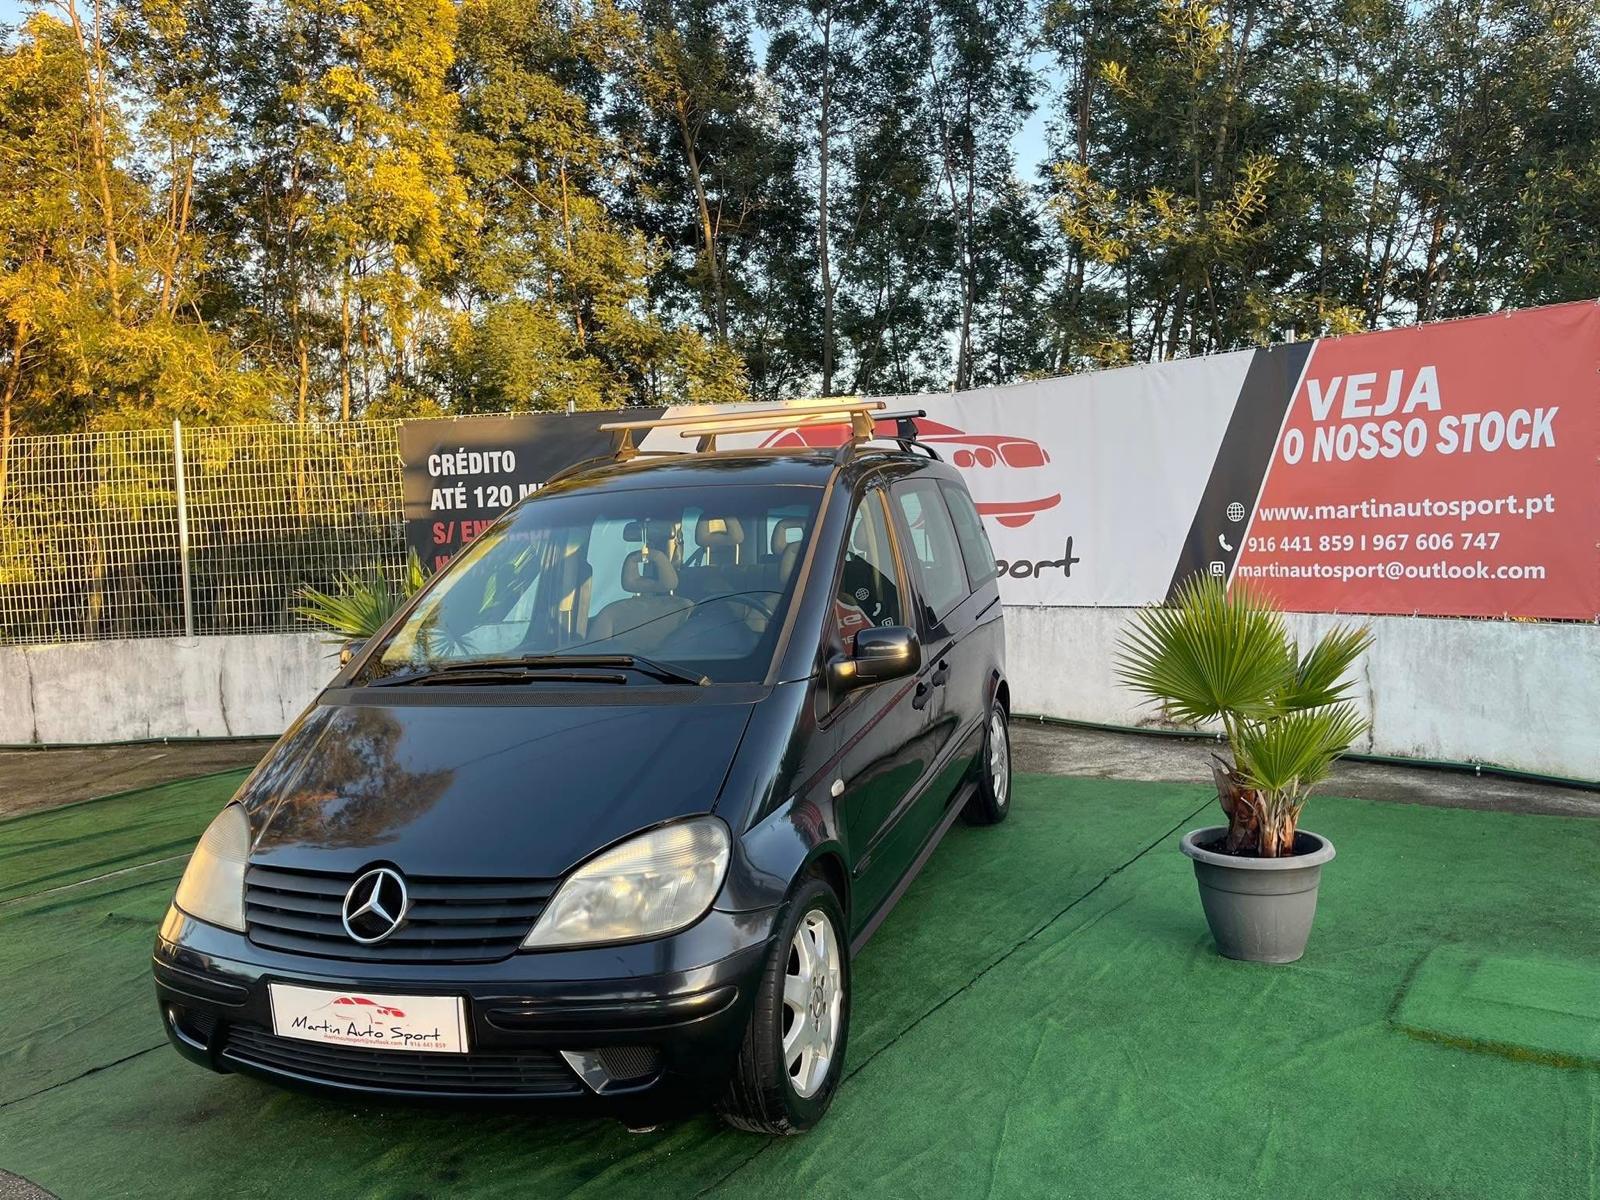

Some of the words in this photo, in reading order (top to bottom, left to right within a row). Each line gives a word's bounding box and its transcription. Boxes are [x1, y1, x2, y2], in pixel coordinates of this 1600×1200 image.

[1305, 365, 1442, 422] VEJA
[1282, 428, 1305, 465] O
[1312, 420, 1428, 463] NOSSO
[1435, 406, 1560, 456] STOCK
[428, 448, 516, 477] CRÉDITO
[430, 481, 467, 511] ATÉ
[473, 485, 513, 509] 120
[1259, 493, 1555, 521] www.martinautosport.pt
[432, 520, 455, 545] S/
[1248, 537, 1276, 553] 916
[1280, 536, 1312, 552] 441
[1318, 535, 1354, 551] 859
[1373, 534, 1409, 551] 967
[1415, 533, 1454, 550] 606
[1461, 532, 1501, 550] 747
[1238, 561, 1546, 582] martinautosport@outlook.com
[291, 1016, 341, 1035] Martin
[347, 1022, 384, 1039] Auto
[390, 1027, 441, 1046] Sport
